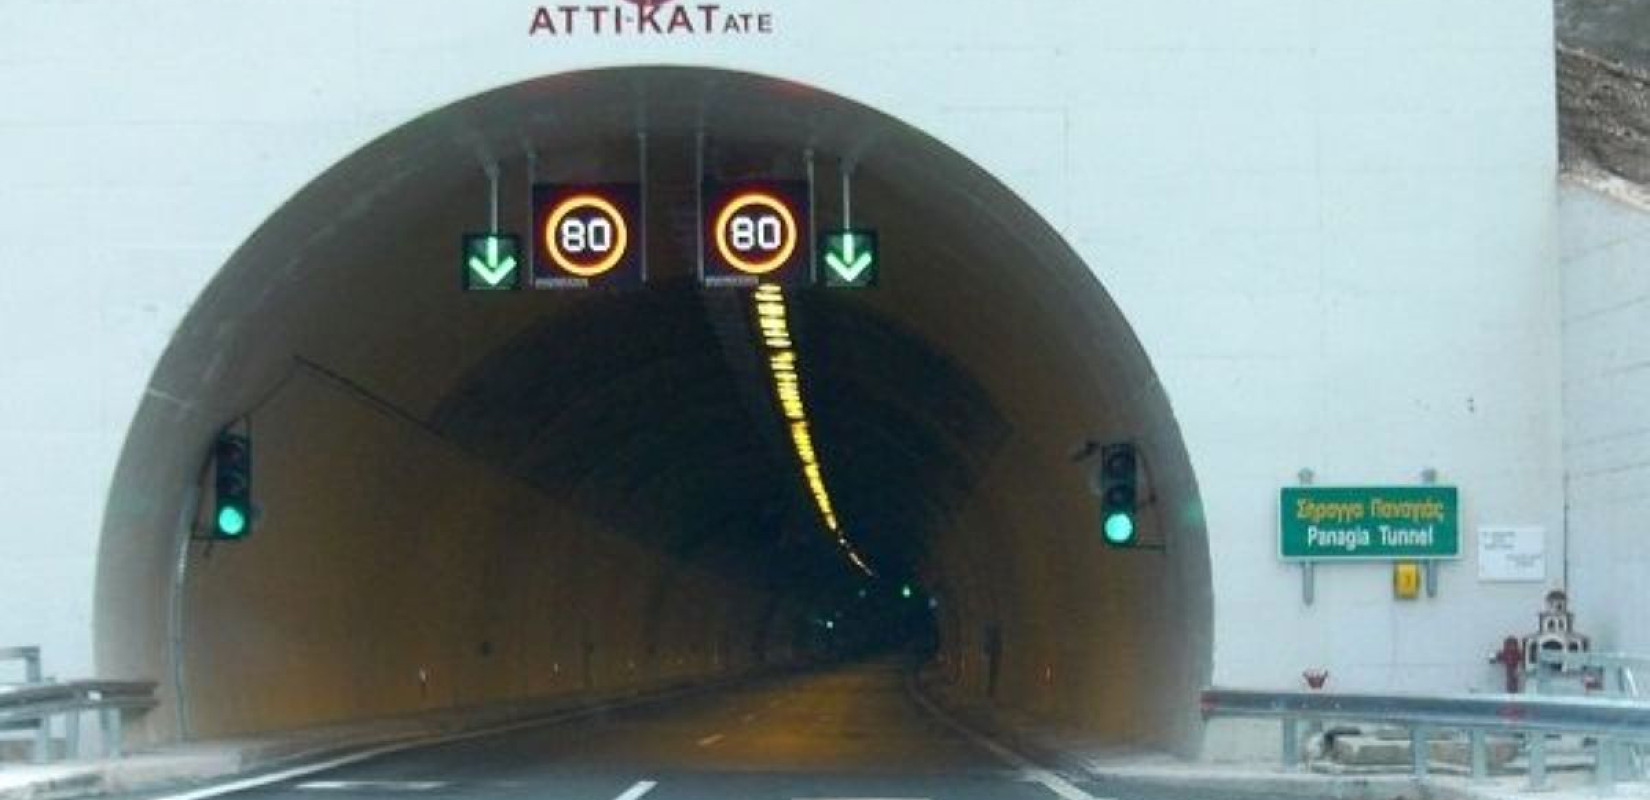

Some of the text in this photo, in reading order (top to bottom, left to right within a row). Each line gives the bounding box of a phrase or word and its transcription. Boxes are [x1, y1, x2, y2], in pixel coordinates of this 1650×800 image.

[560, 217, 612, 252] 80
[731, 216, 782, 250] 80
[1308, 525, 1434, 550] Panagia Tunnel
